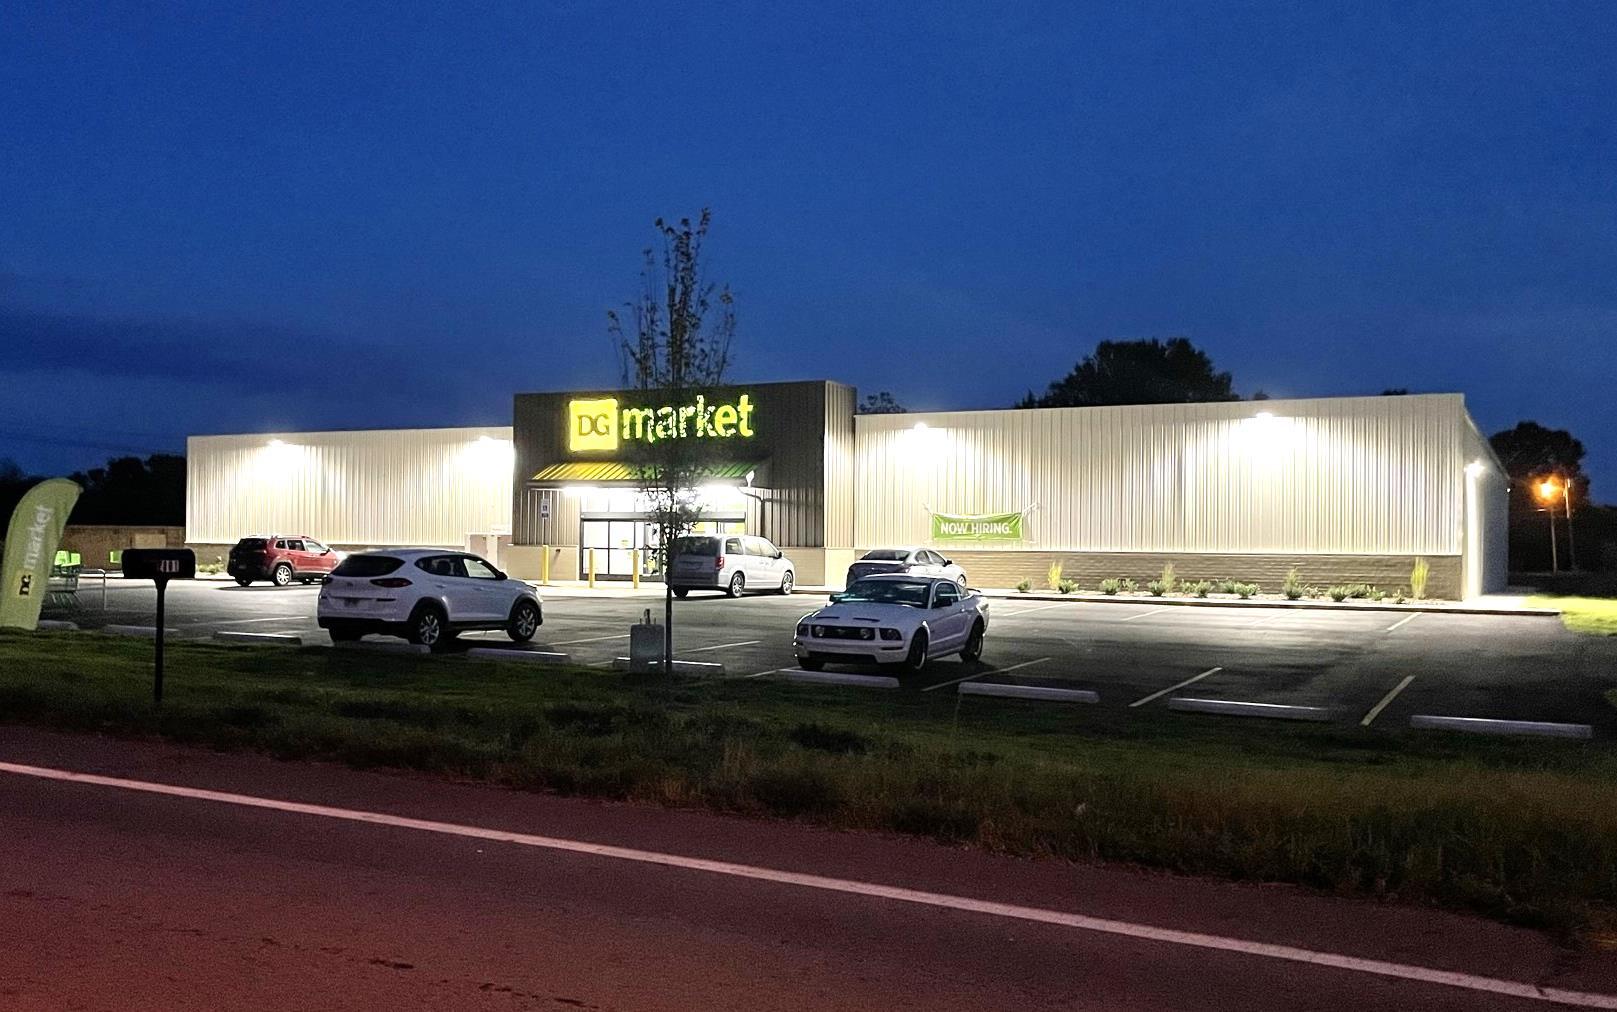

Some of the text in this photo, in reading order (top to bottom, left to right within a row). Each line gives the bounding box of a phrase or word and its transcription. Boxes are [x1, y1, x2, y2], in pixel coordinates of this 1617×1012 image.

[577, 394, 754, 443] DG market
[24, 506, 54, 569] market
[940, 522, 968, 534] NOW
